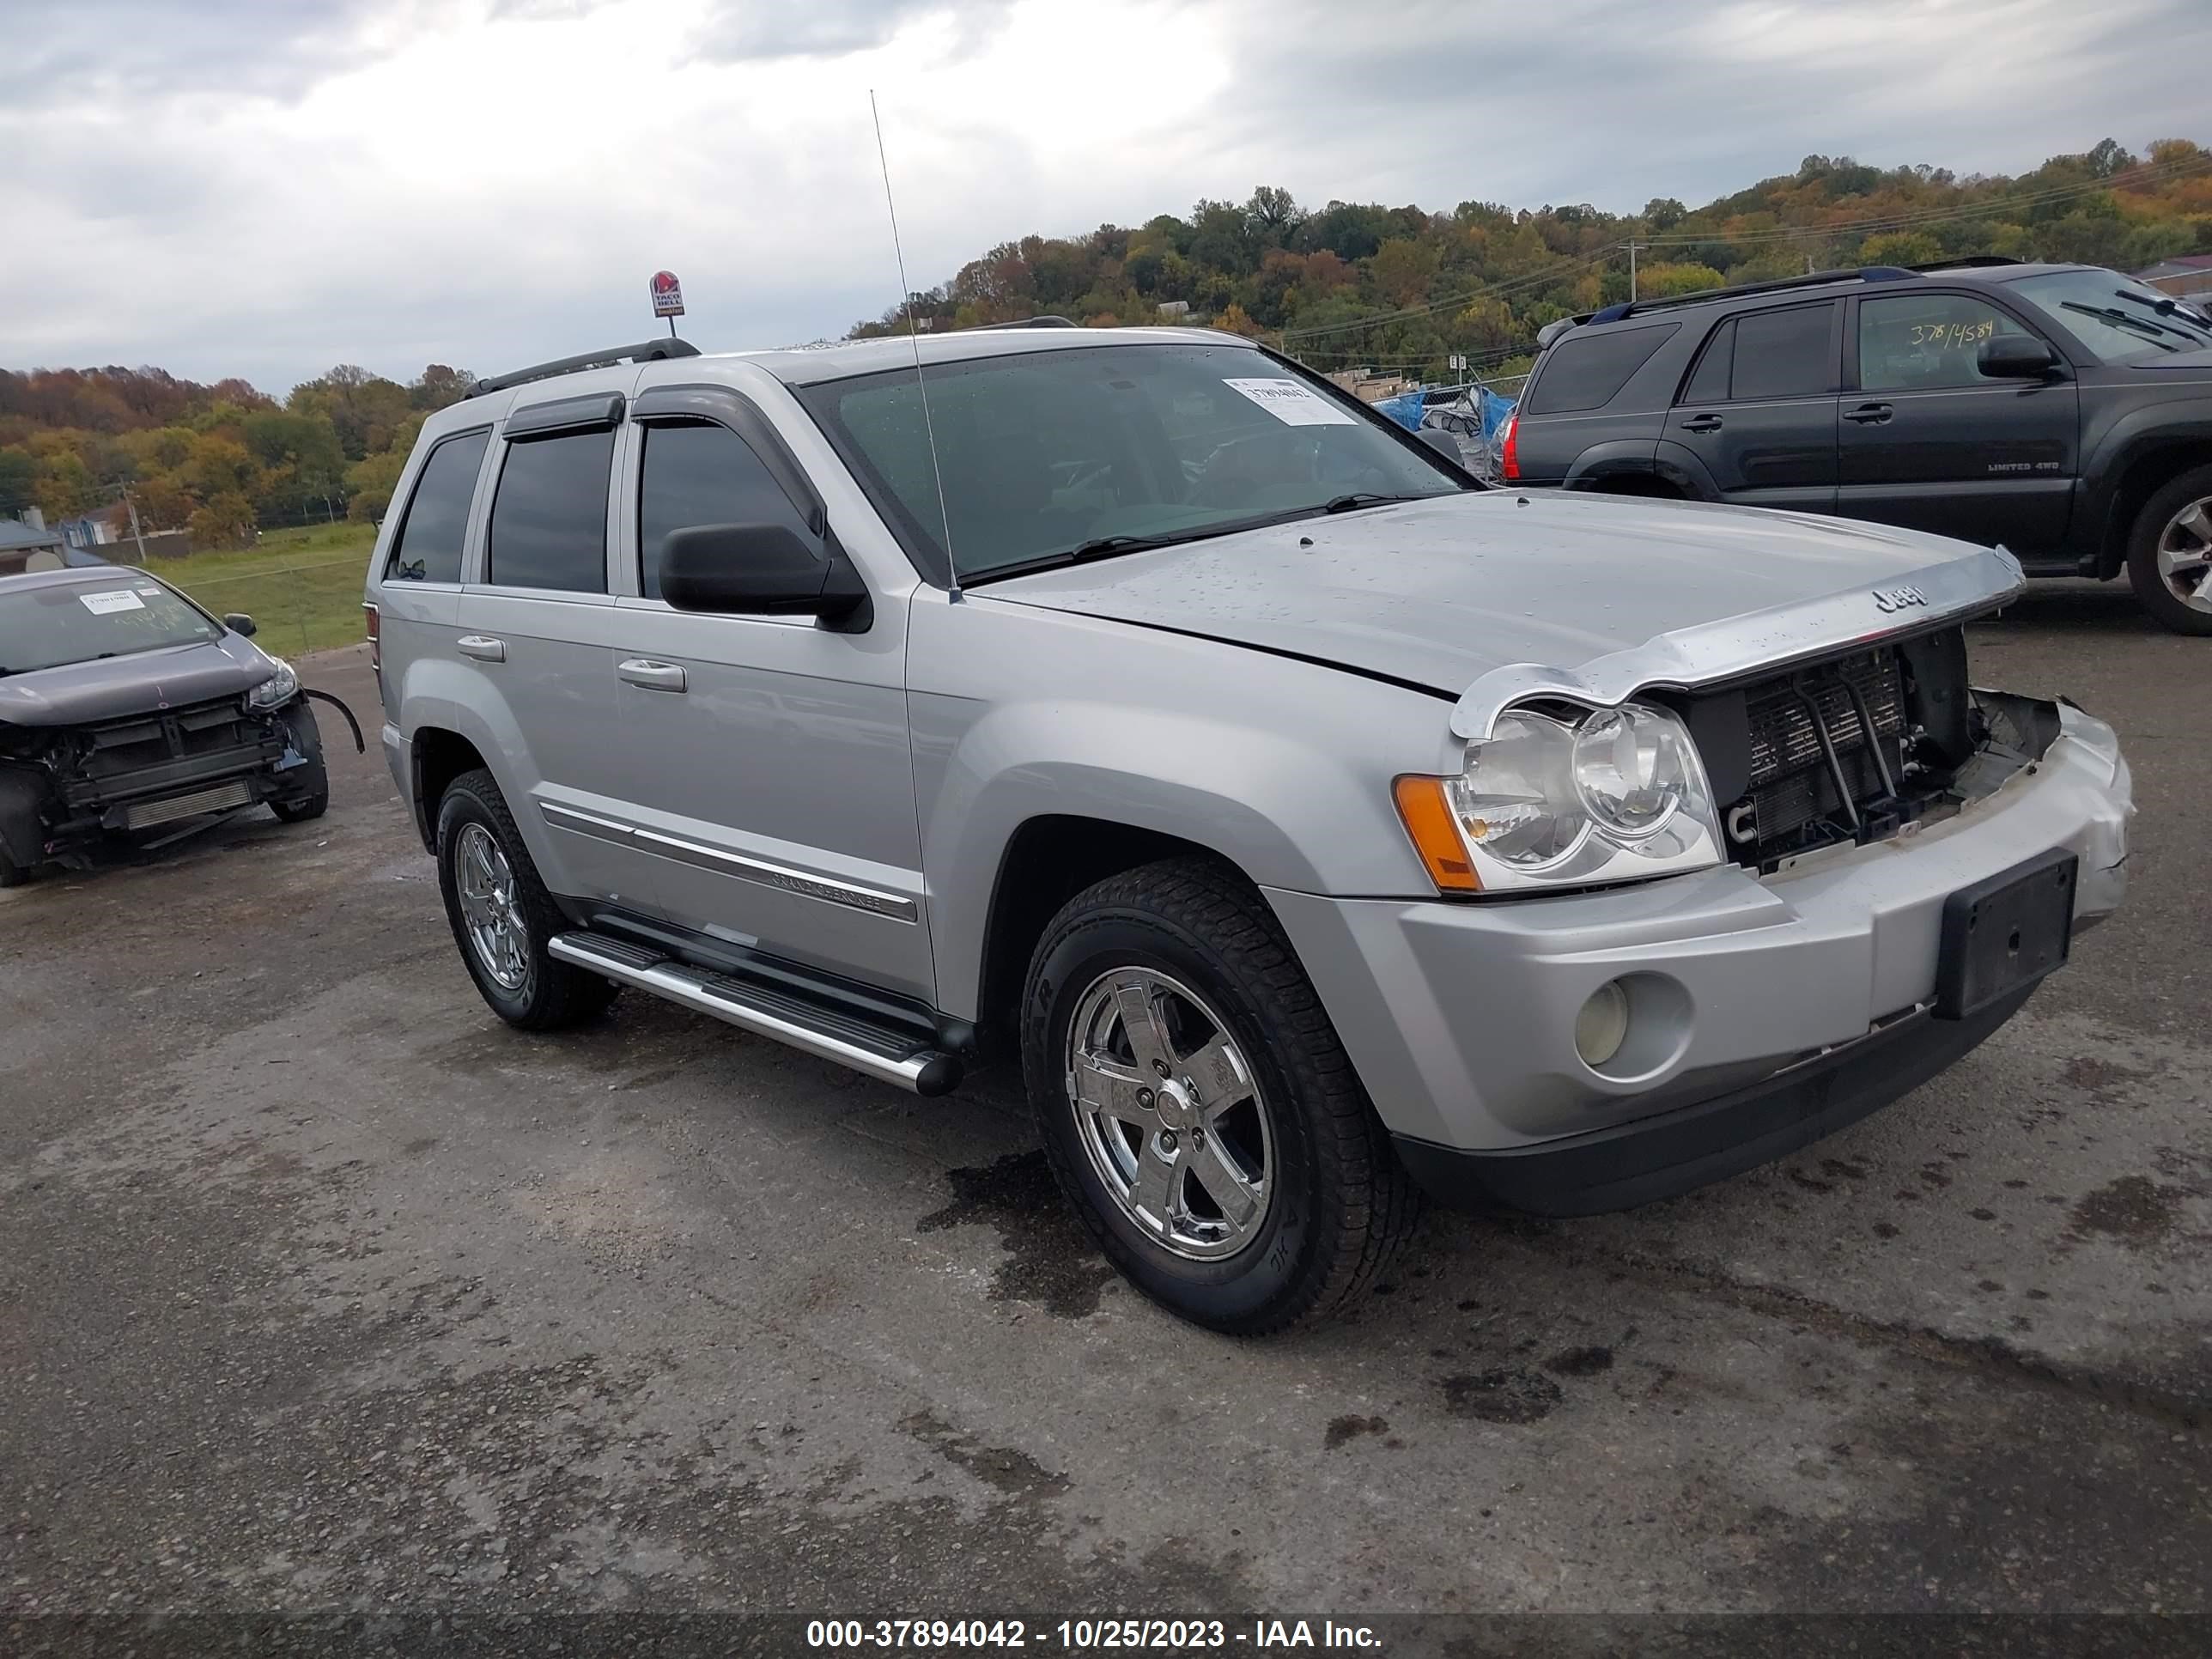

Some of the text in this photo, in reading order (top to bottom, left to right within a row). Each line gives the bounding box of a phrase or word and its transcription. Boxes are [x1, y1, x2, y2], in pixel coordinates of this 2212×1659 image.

[1247, 388, 1310, 399] 37894042
[1988, 461, 2059, 471] LIMITED 4WD
[1872, 584, 1929, 613] Jeep
[770, 873, 882, 911] GRAND CHEROKEE
